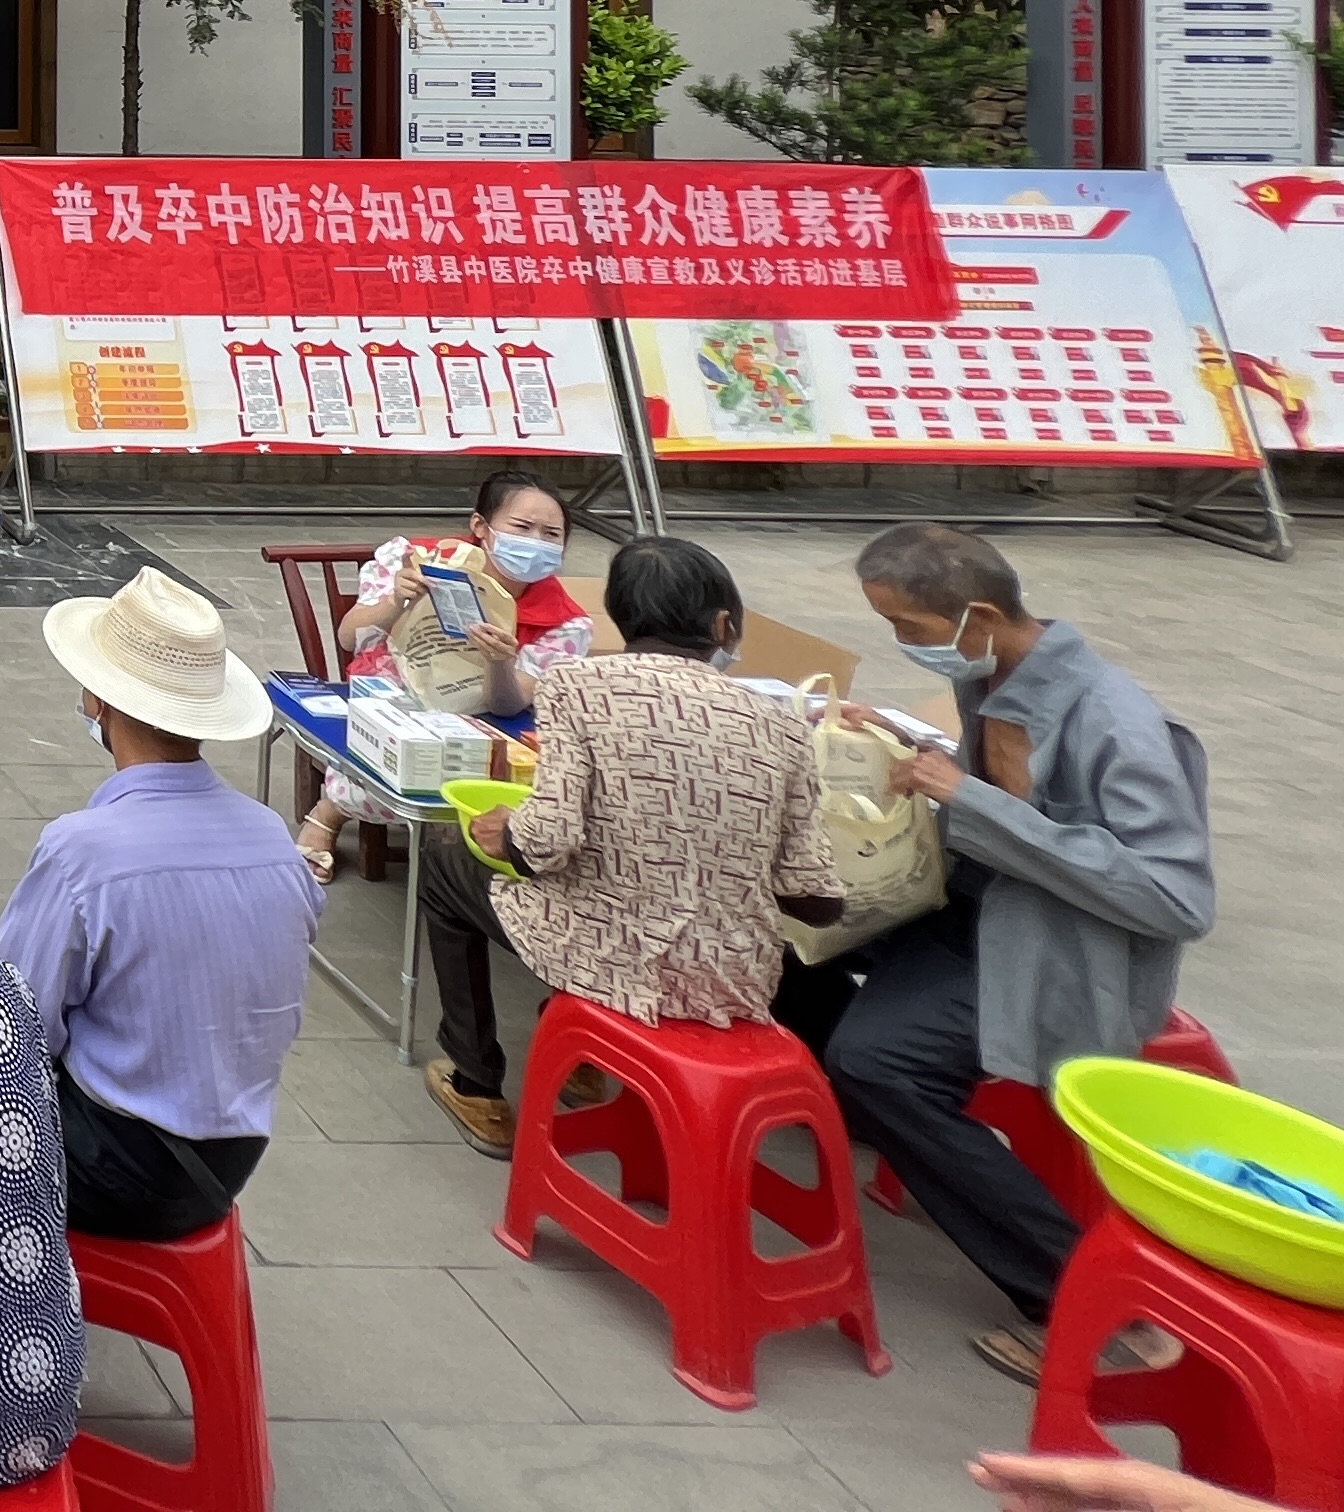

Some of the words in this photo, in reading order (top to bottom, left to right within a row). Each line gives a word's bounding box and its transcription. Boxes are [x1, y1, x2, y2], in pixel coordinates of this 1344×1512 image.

[51, 181, 464, 246] 普及卒中防治知识
[475, 183, 893, 249] 提高群众健康素养
